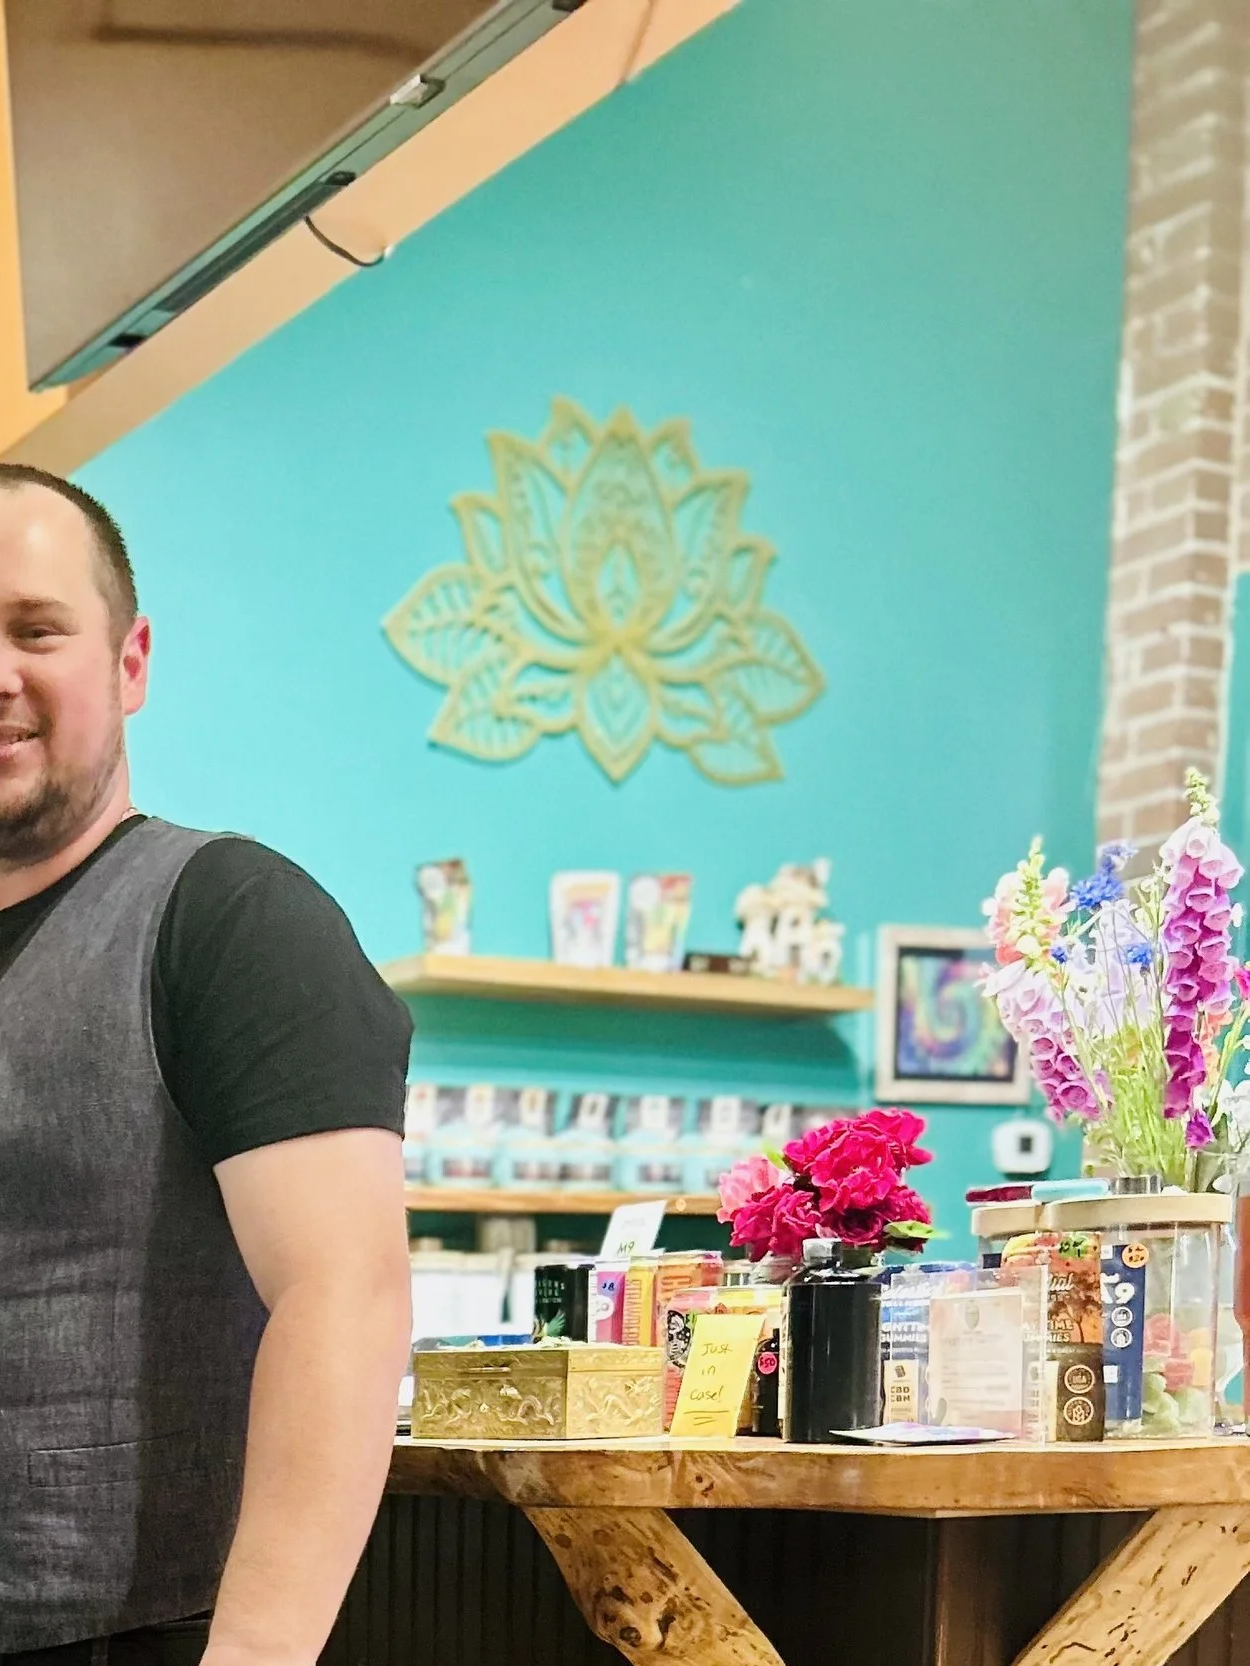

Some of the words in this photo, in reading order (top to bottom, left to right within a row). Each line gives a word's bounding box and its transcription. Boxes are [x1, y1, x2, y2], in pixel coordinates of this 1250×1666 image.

[622, 1279, 642, 1346] STRAWBERR
[701, 1342, 733, 1356] Just
[701, 1365, 717, 1376] in
[890, 1386, 911, 1394] CBD
